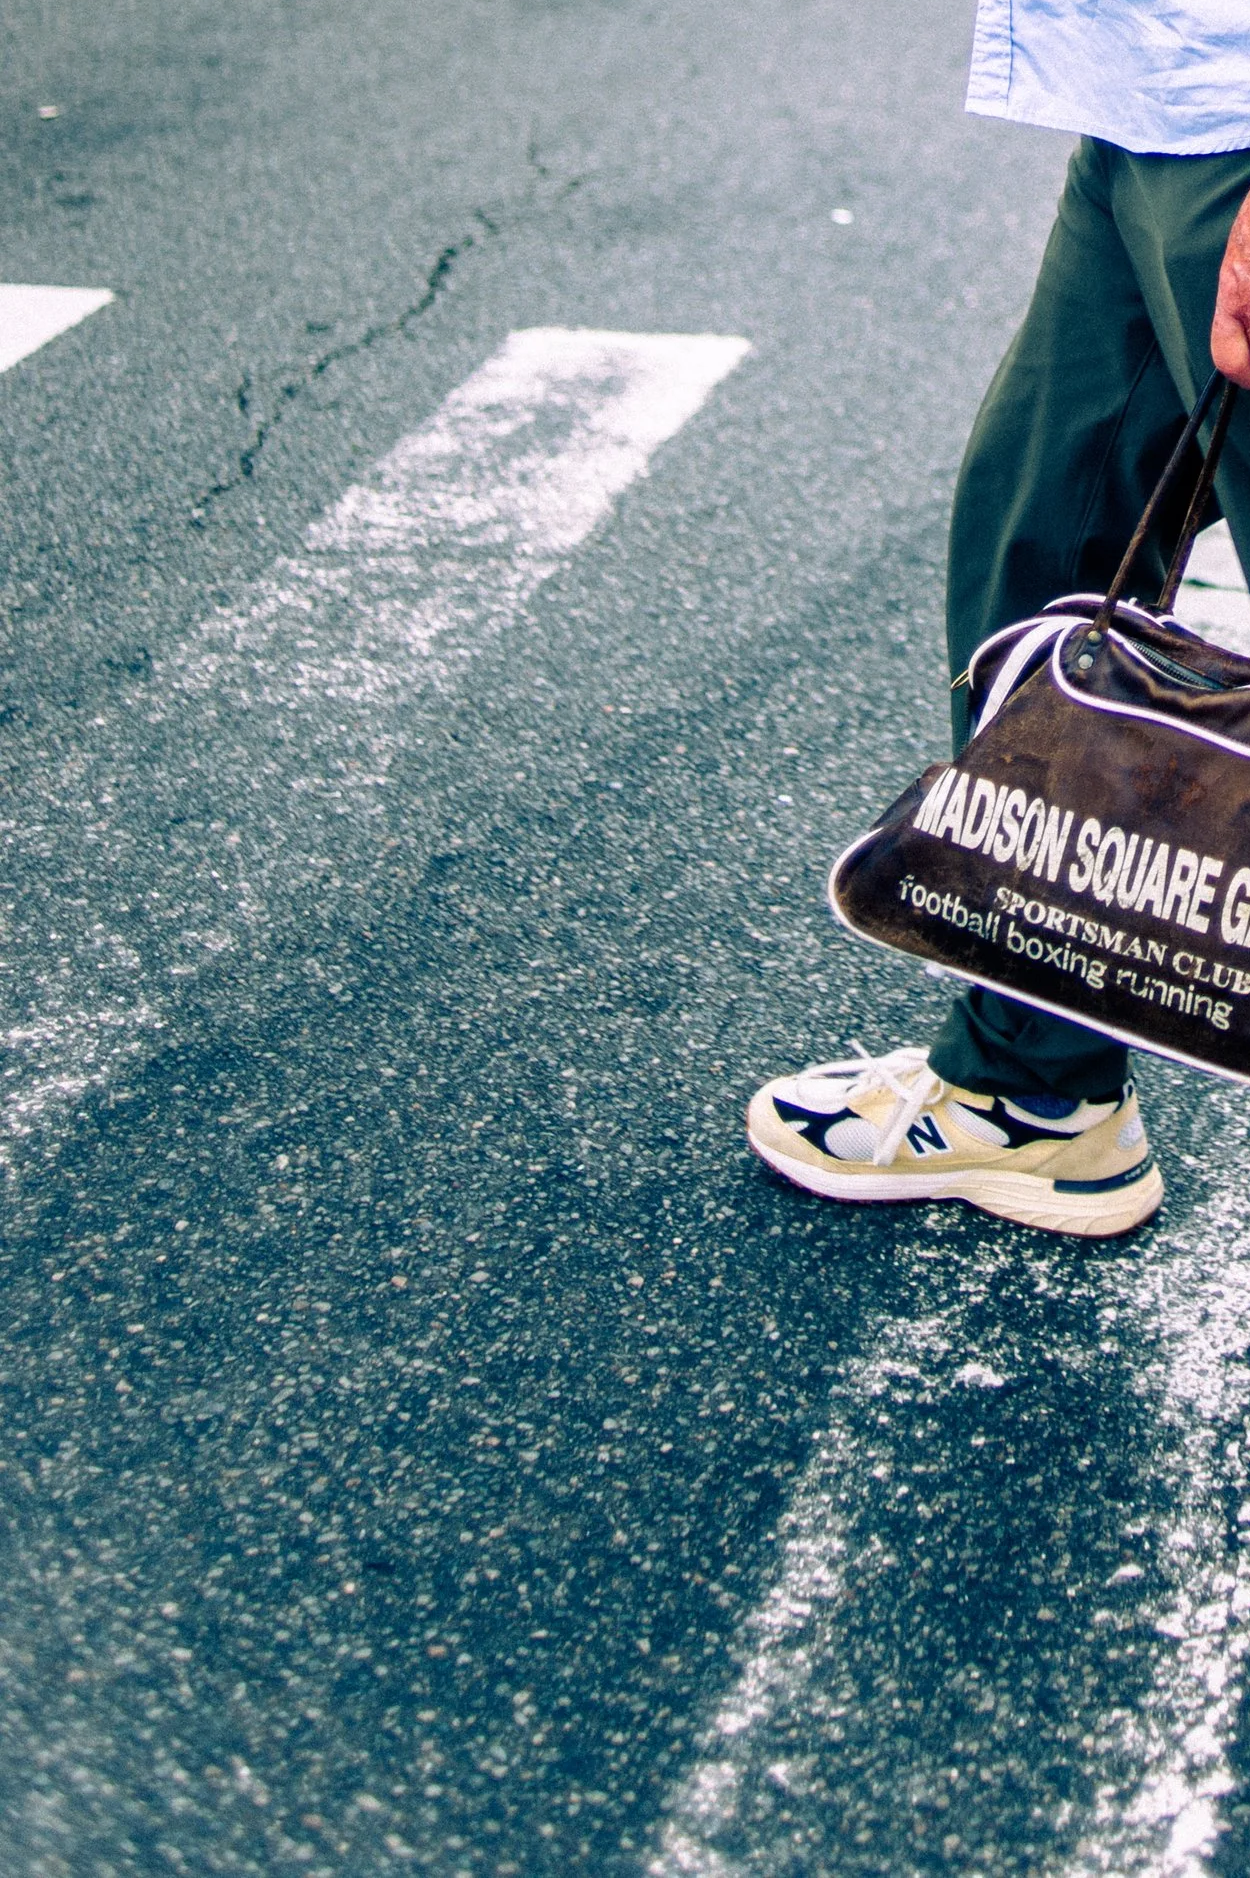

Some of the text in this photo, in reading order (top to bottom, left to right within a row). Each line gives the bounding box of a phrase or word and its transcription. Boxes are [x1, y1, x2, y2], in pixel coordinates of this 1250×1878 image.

[912, 767, 1075, 883] MADISON
[1068, 817, 1224, 934] SQUARE
[899, 874, 1234, 1031] football boxing running
[996, 886, 1169, 967] SPORTSMAN
[904, 1114, 950, 1156] N
